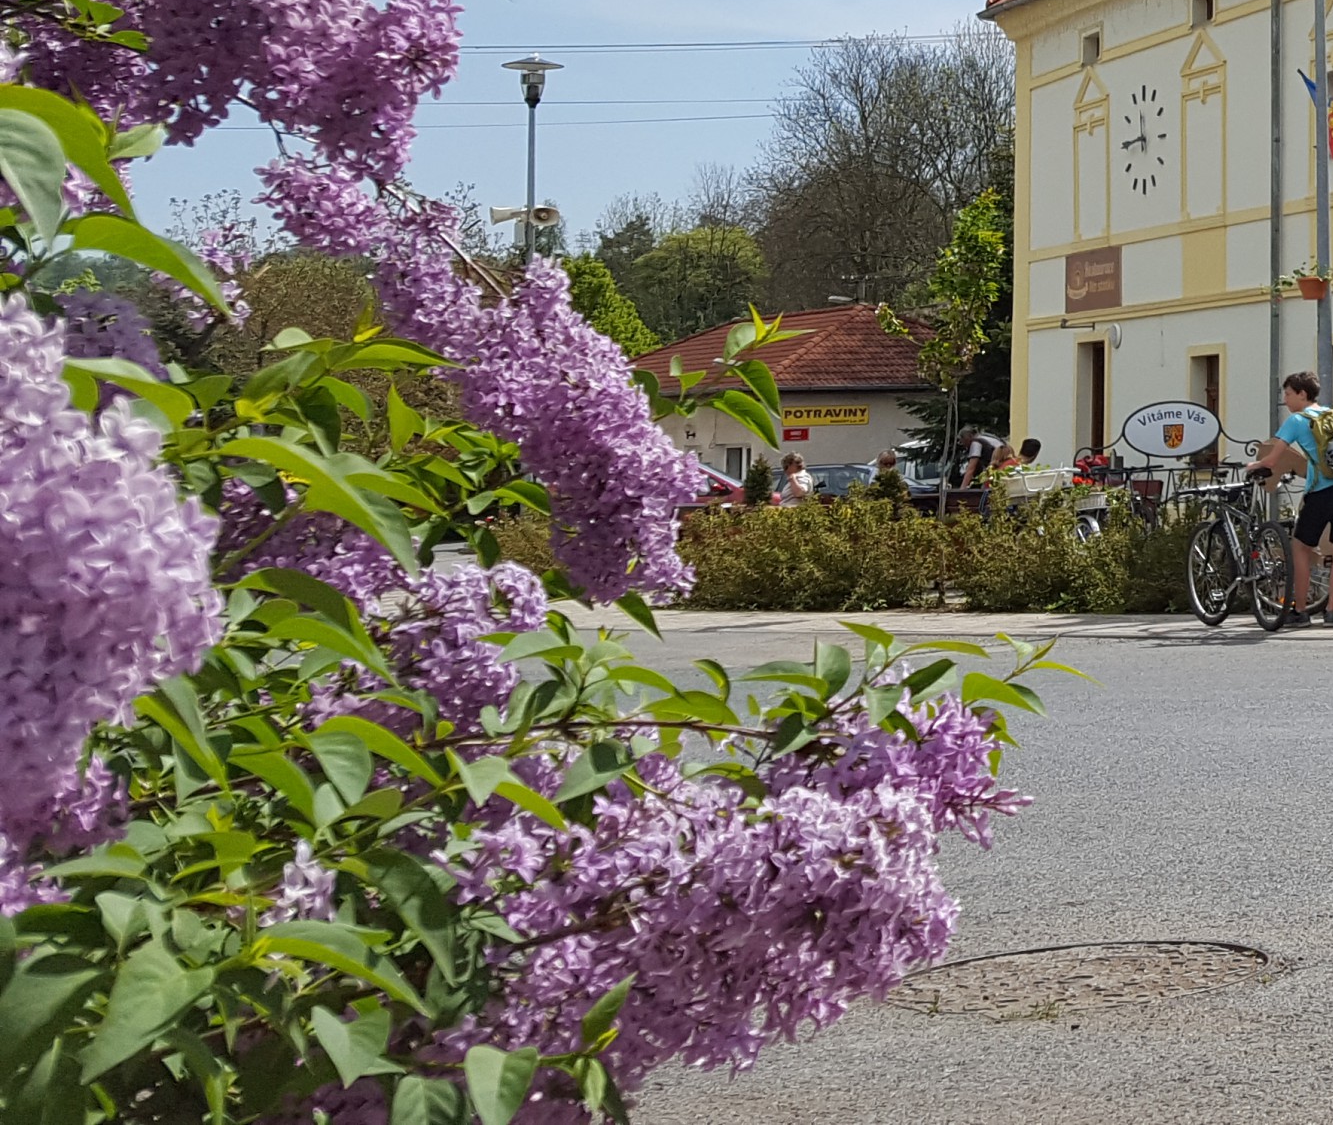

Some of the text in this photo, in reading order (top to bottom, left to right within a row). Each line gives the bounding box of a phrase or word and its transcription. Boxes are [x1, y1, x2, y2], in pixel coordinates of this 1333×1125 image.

[784, 408, 867, 419] POTRAVINY
[1137, 409, 1207, 427] Vitáme Vás
